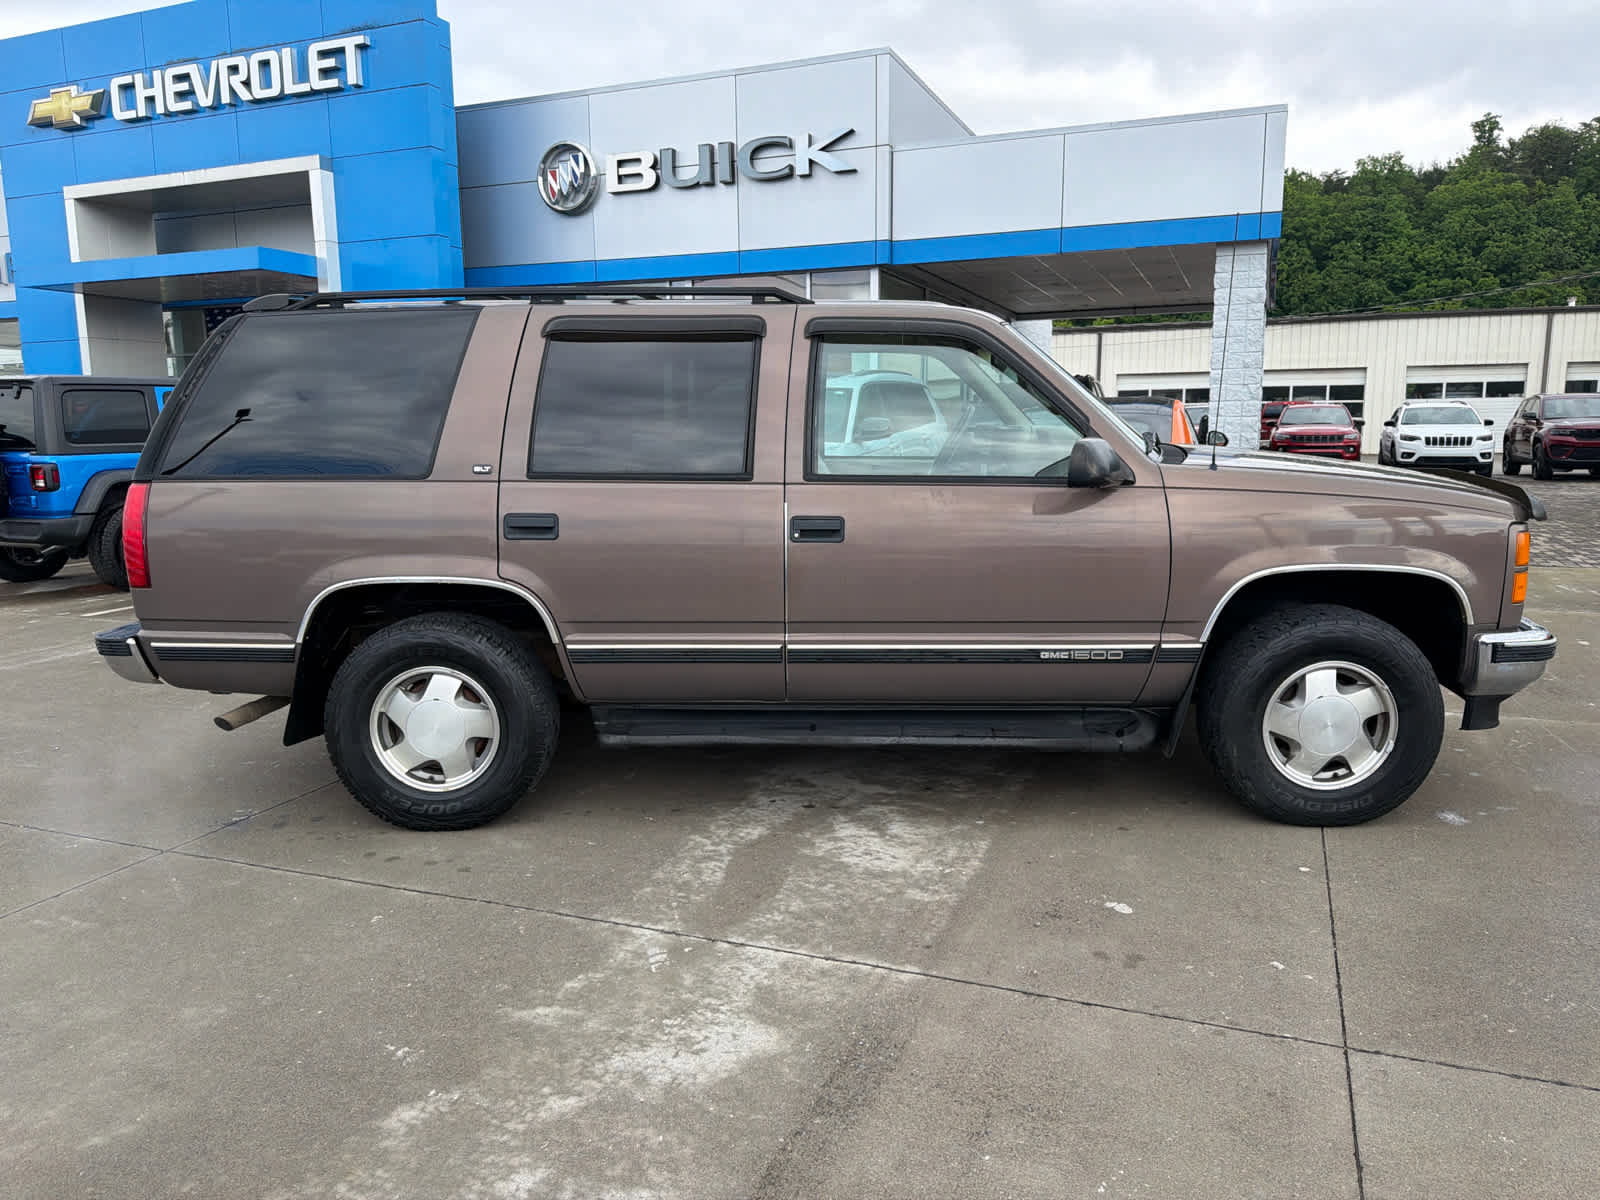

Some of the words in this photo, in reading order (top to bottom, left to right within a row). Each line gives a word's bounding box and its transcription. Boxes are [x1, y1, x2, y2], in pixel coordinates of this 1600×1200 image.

[110, 35, 370, 122] CHEVROLET
[605, 128, 858, 194] BUICK
[1040, 651, 1069, 659] GMC
[1070, 650, 1123, 660] 1500
